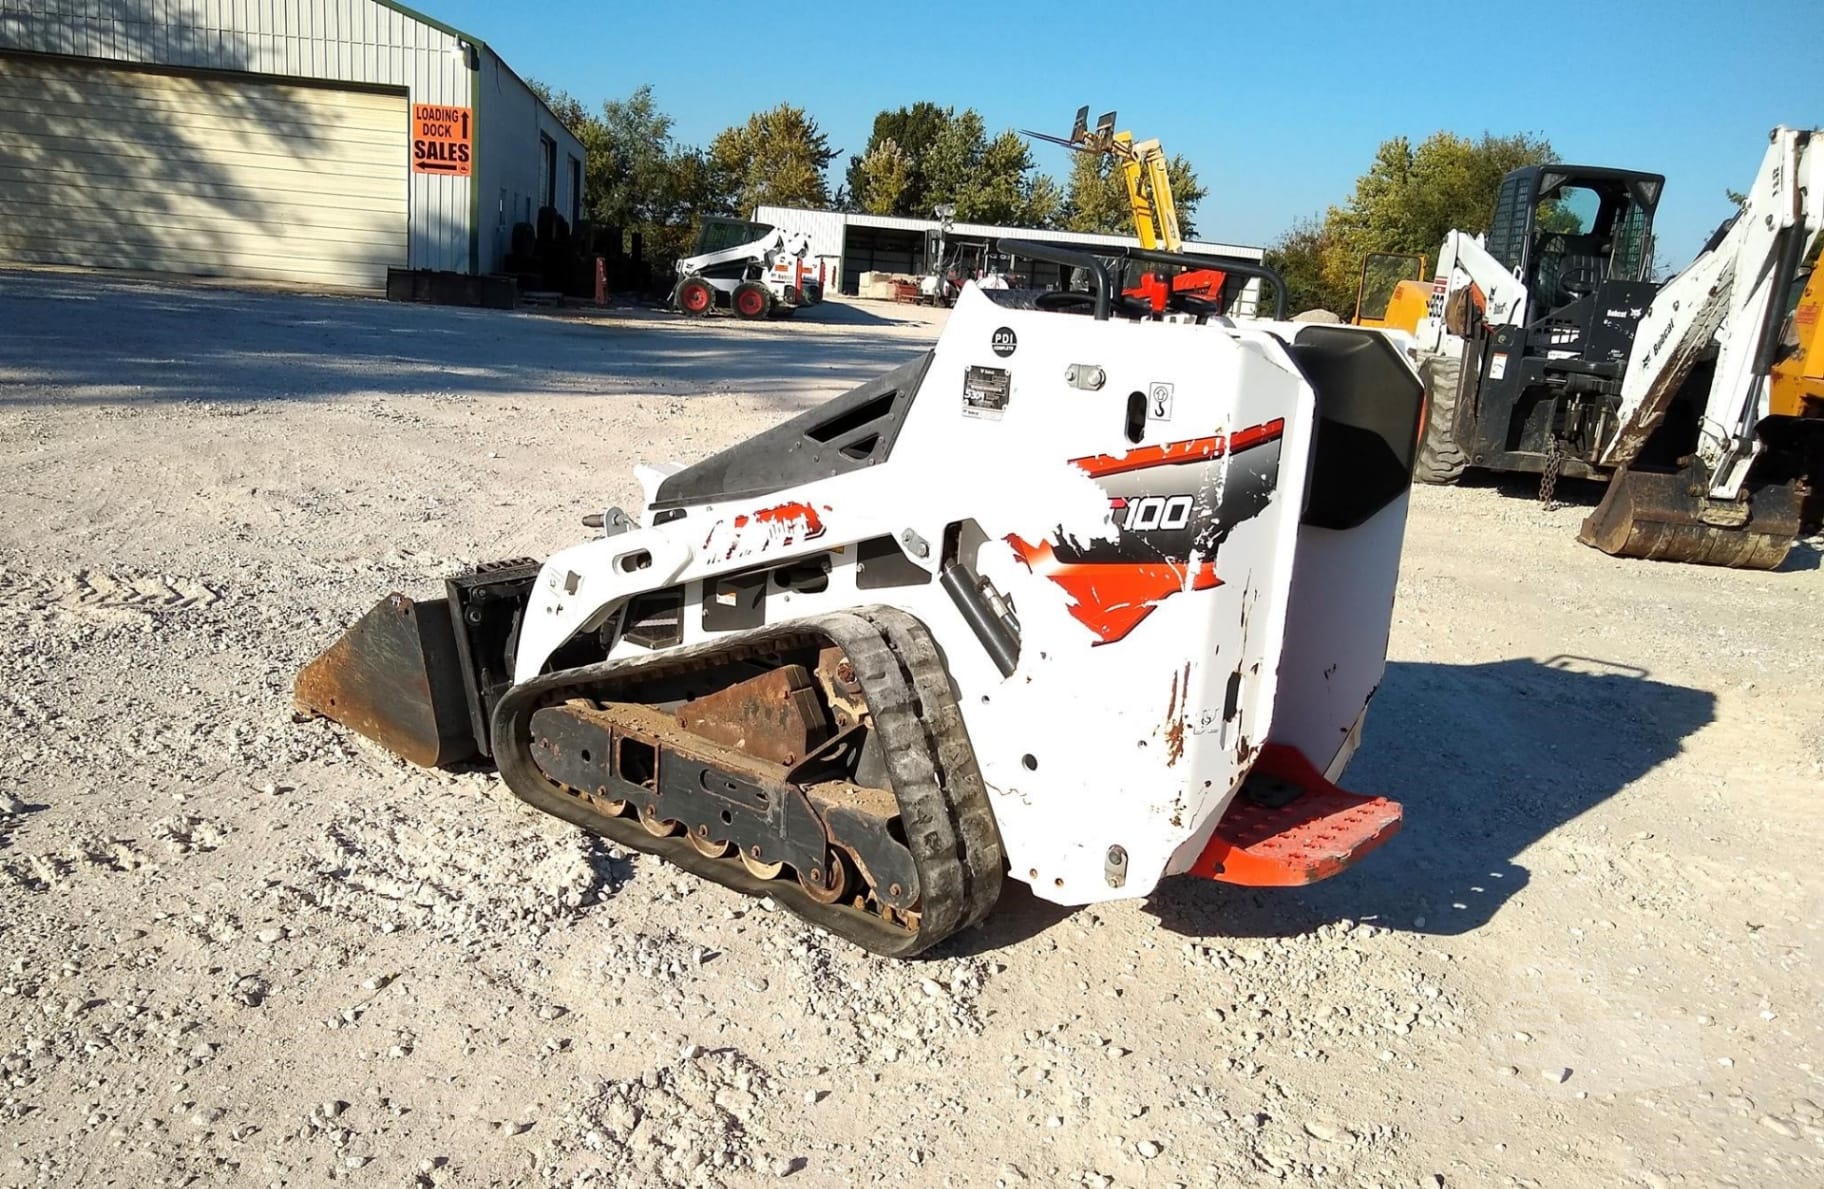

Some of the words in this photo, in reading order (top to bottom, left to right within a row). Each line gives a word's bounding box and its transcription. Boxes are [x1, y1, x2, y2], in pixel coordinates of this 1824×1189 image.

[417, 106, 459, 123] LOADING
[423, 123, 452, 138] DOCK
[414, 140, 469, 162] SALES
[995, 333, 1014, 344] PDI
